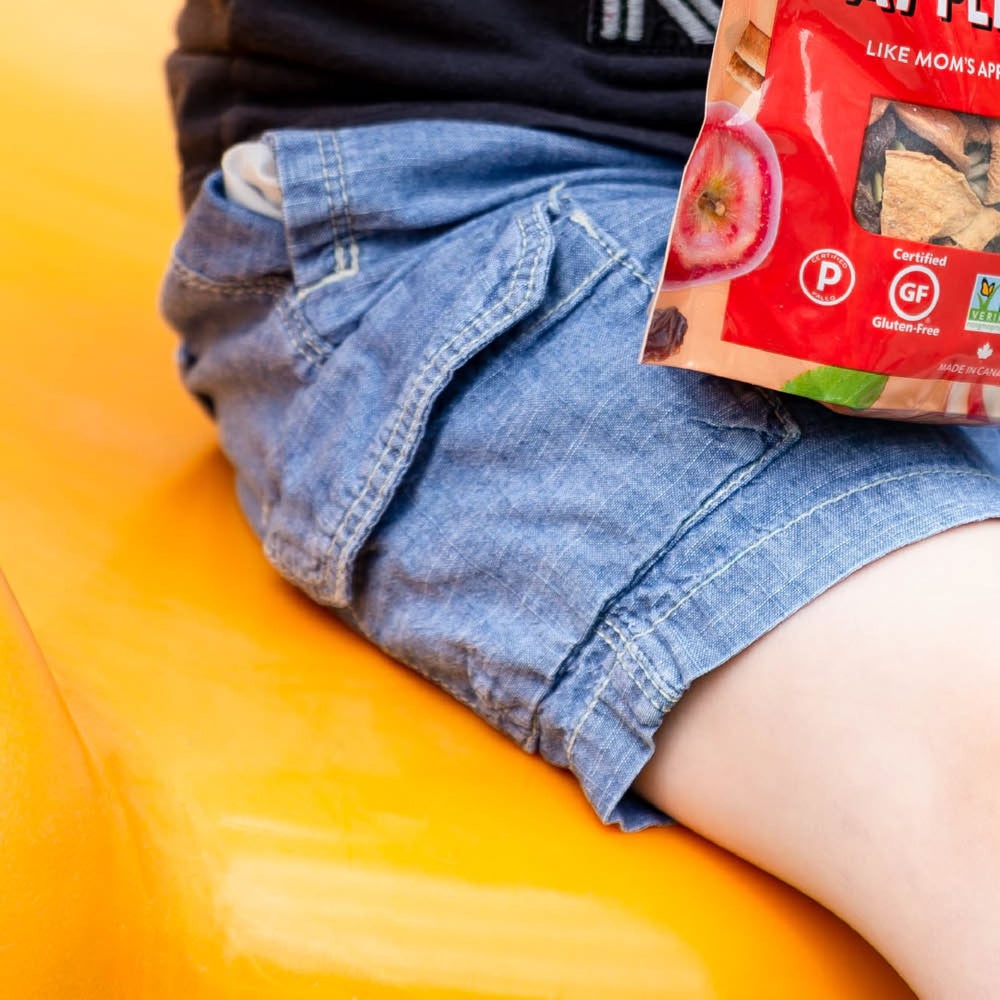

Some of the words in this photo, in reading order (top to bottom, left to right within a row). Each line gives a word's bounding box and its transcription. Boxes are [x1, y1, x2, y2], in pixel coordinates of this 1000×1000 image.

[866, 40, 911, 63] LIKE
[915, 50, 975, 75] MOM'S
[893, 248, 947, 267] Certified
[816, 261, 842, 291] P
[899, 282, 929, 303] GF
[872, 316, 940, 336] Gluten-Free
[937, 363, 966, 375] MADE
[966, 366, 976, 375] IN
